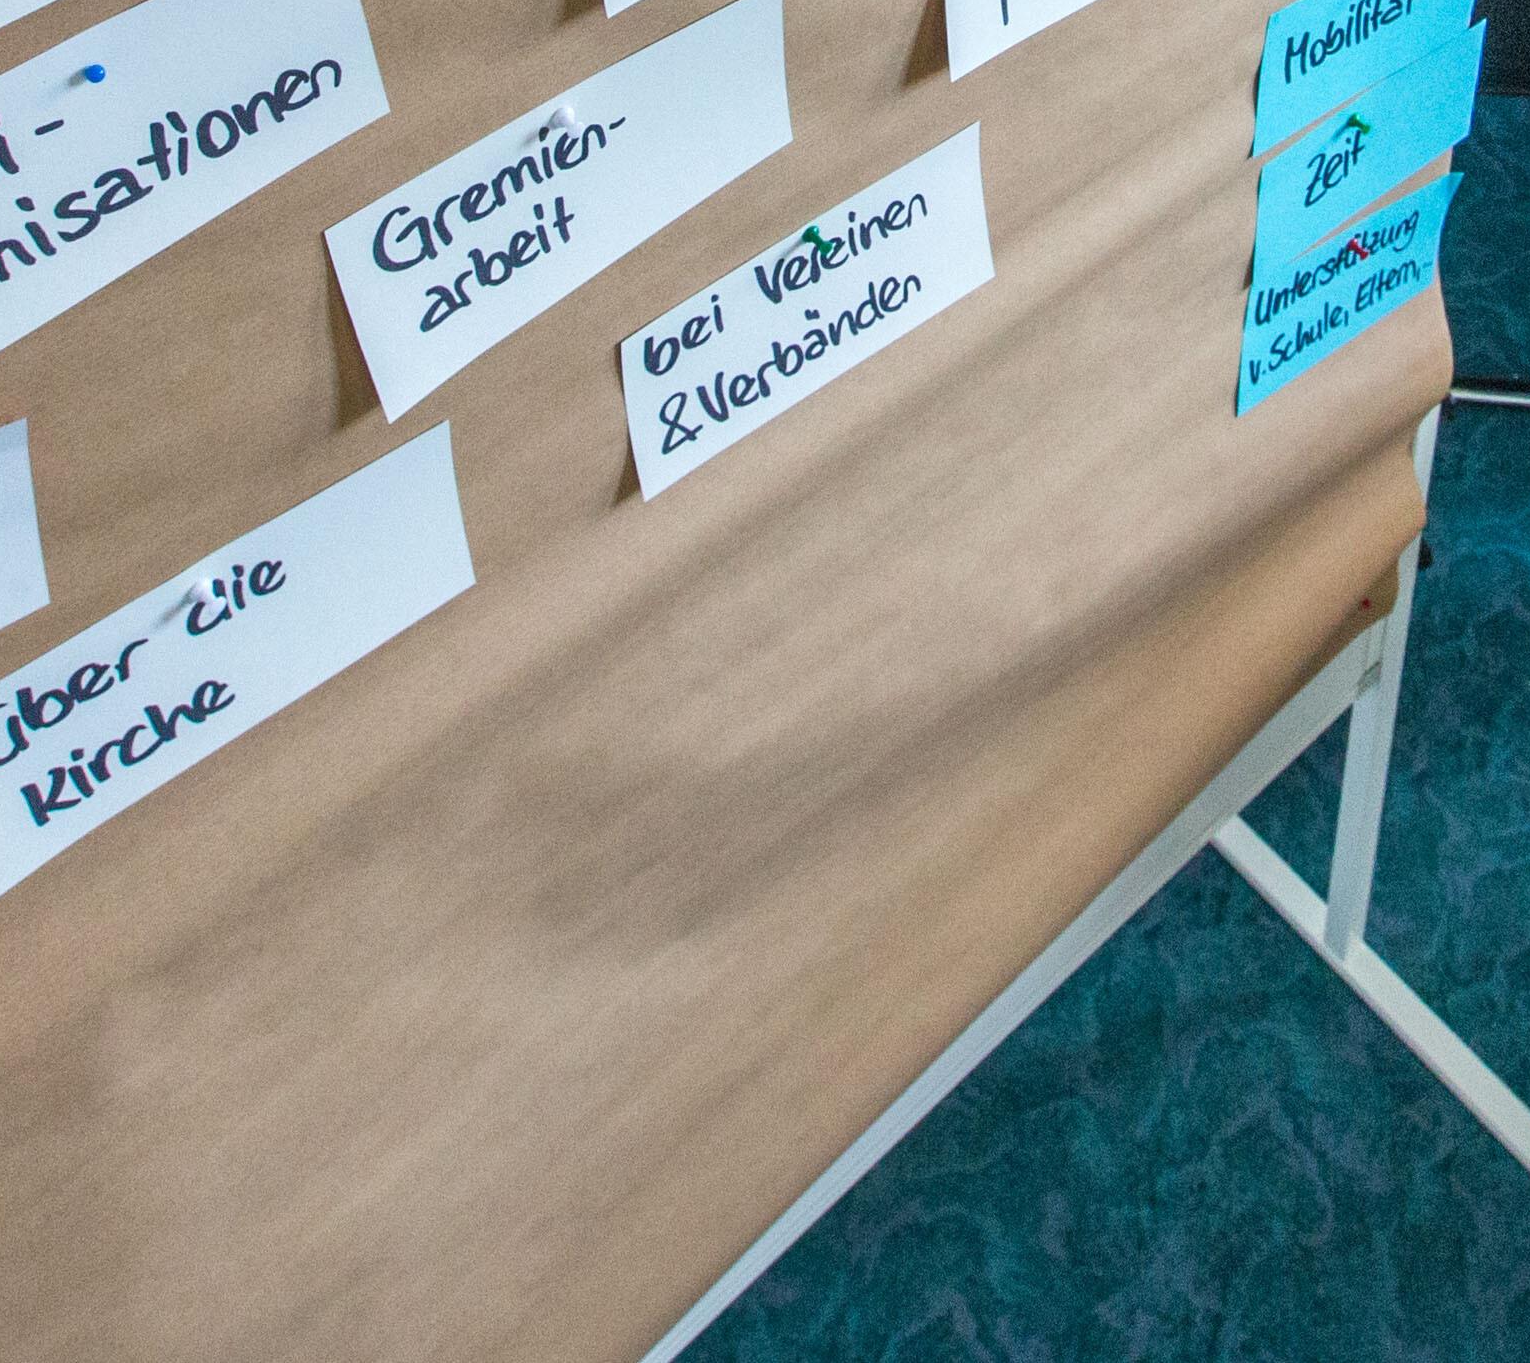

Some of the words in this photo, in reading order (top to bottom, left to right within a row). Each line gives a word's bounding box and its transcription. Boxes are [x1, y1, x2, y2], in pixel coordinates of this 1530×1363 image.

[372, 118, 625, 272] Gremien-
[1304, 130, 1365, 208] Zeit
[419, 196, 575, 333] arbeit
[643, 294, 724, 377] bei
[754, 193, 928, 304] Vereinen
[186, 560, 287, 636] die
